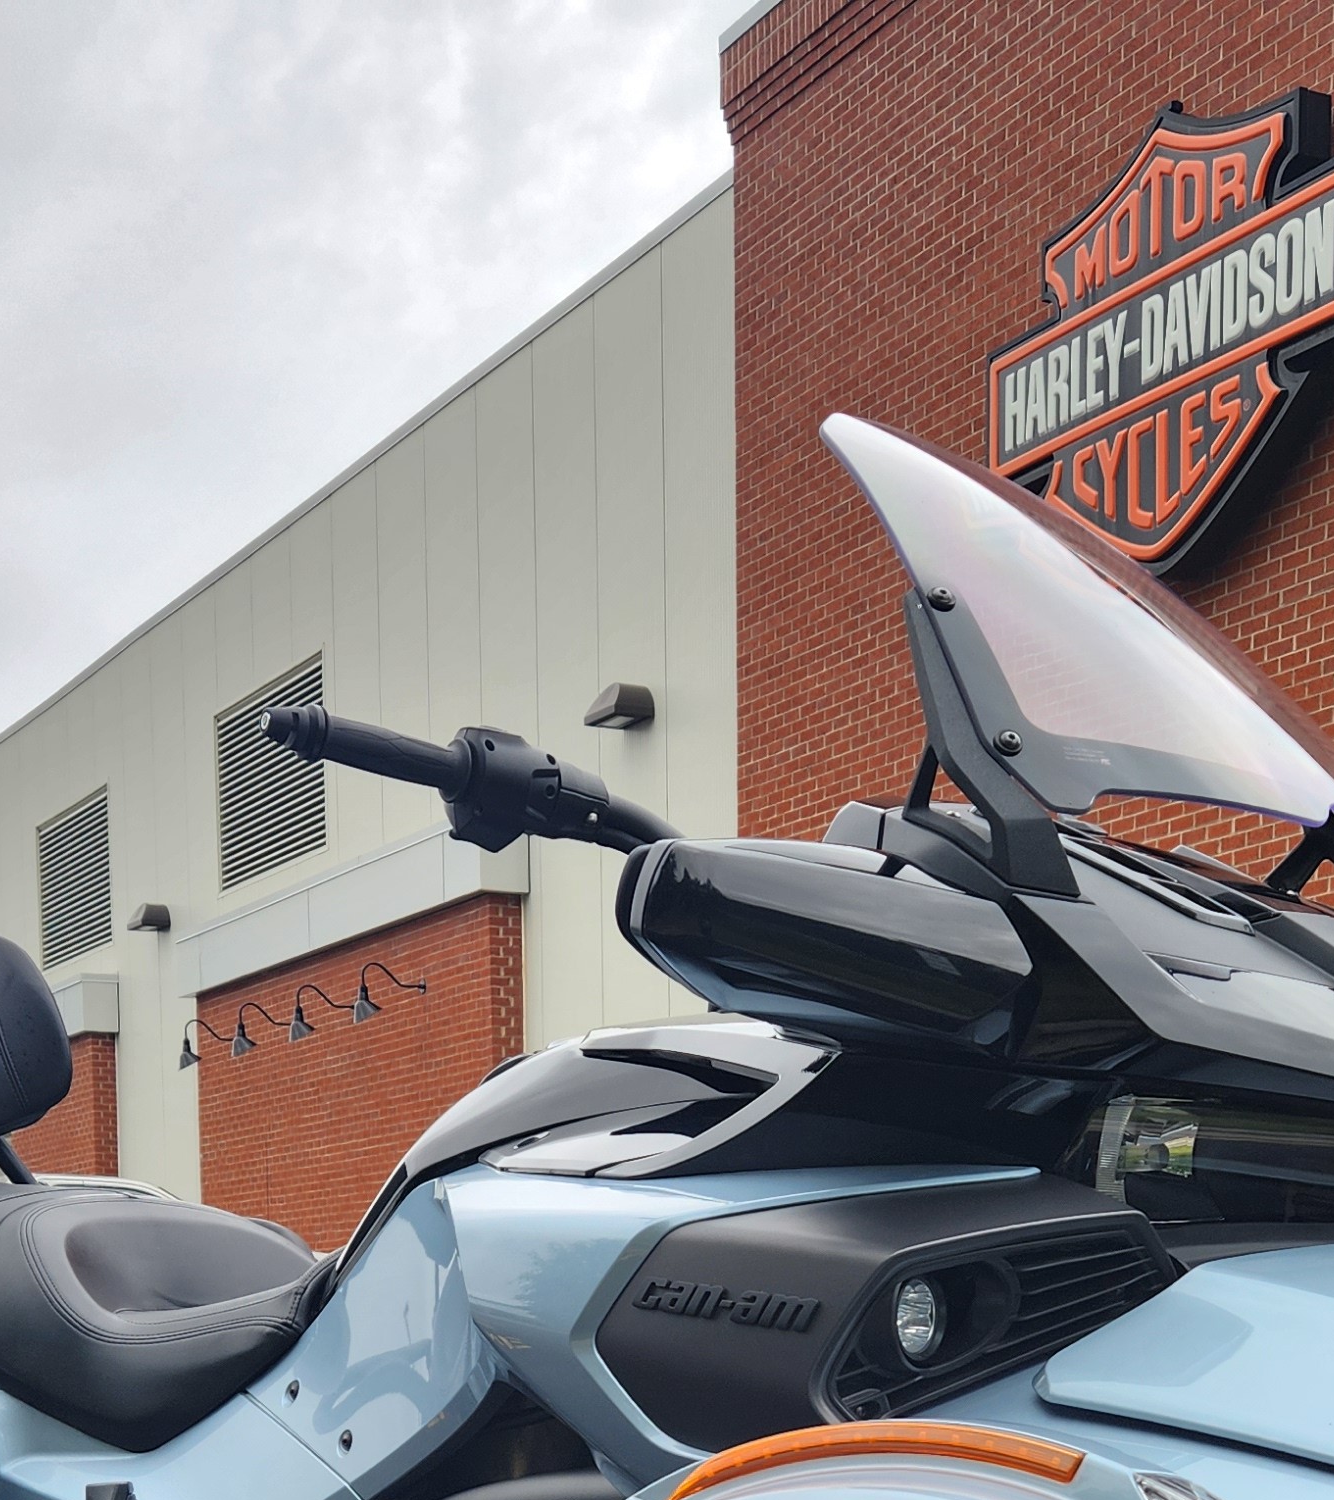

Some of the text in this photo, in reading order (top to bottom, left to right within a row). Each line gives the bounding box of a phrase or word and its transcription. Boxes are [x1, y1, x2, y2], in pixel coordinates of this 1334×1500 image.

[1074, 153, 1248, 300] MOTOR
[1072, 375, 1242, 531] CYCLES
[631, 1275, 821, 1333] can-am
